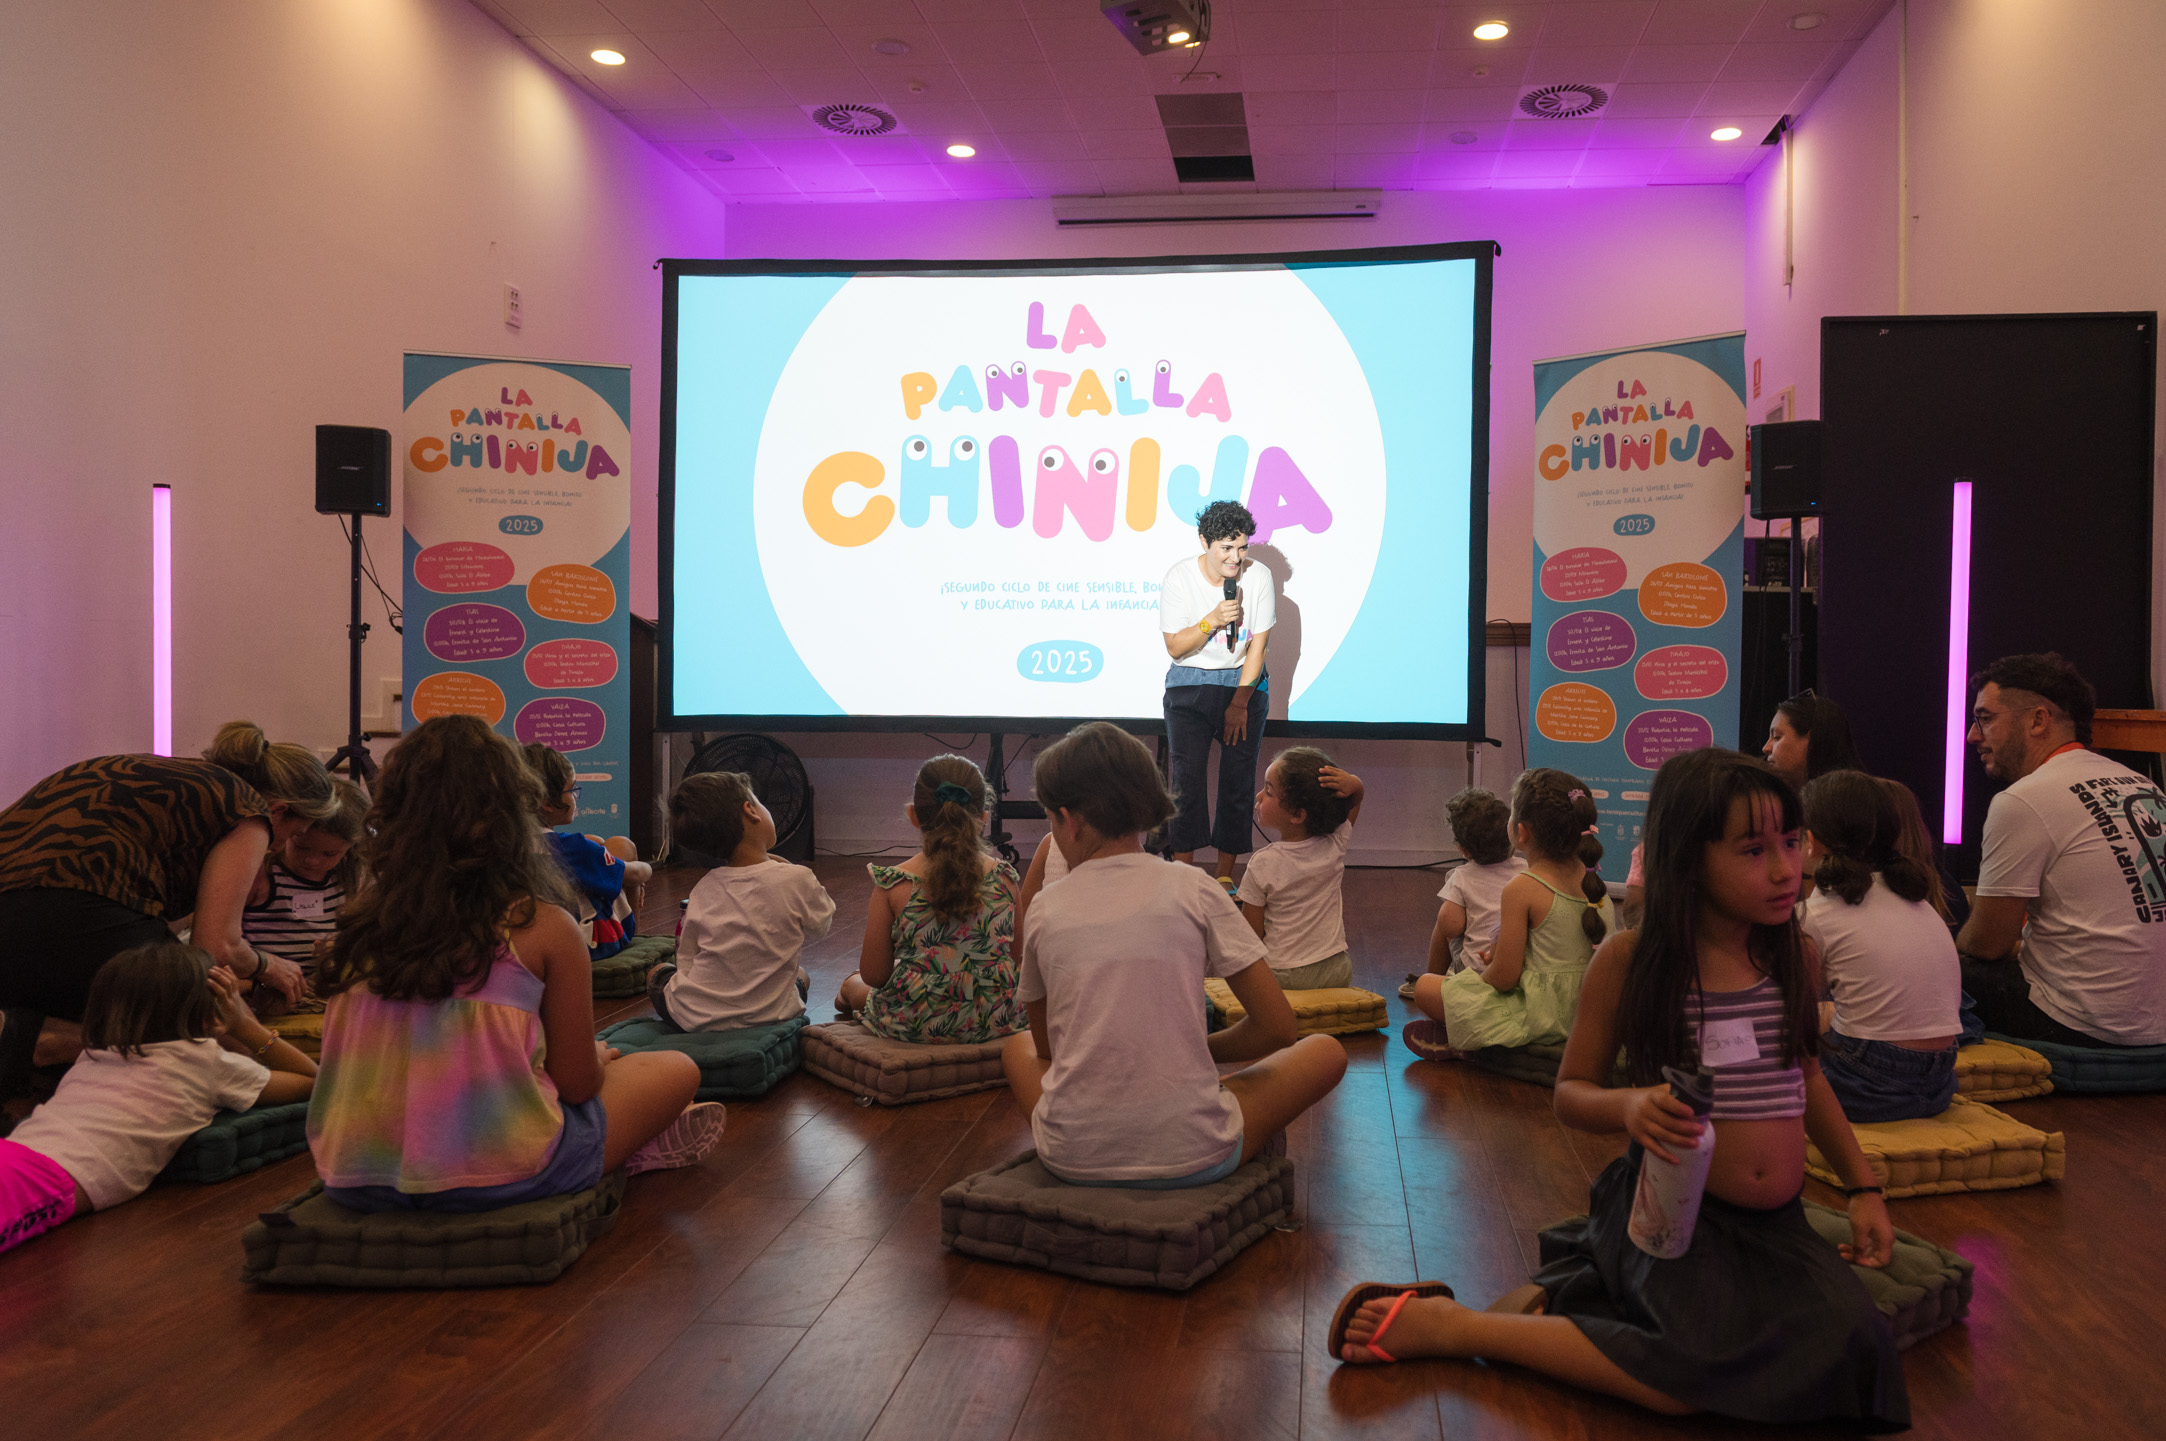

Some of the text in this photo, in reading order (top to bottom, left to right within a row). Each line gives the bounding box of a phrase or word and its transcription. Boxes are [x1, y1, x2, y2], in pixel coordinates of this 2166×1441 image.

[1027, 301, 1106, 353] LA
[501, 387, 533, 407] LA
[900, 359, 1231, 422] PANTALLA
[1617, 379, 1647, 399] LA
[450, 407, 582, 436] PANTALLA
[1572, 397, 1694, 430] PANTALLA
[410, 432, 620, 480] CHINIJA
[1538, 424, 1734, 481] CHINIJA
[802, 434, 1333, 548] CHINIJA
[505, 519, 539, 533] 2025
[1619, 518, 1650, 533] 2025
[1002, 581, 1031, 593] CICLO
[1038, 581, 1050, 593] DE
[1056, 581, 1080, 593] CINE
[961, 600, 968, 611] Y
[975, 598, 1035, 611] EDUCATIVO
[1041, 599, 1075, 611] PARA
[1081, 599, 1100, 611] LA
[1031, 649, 1093, 675] 2025
